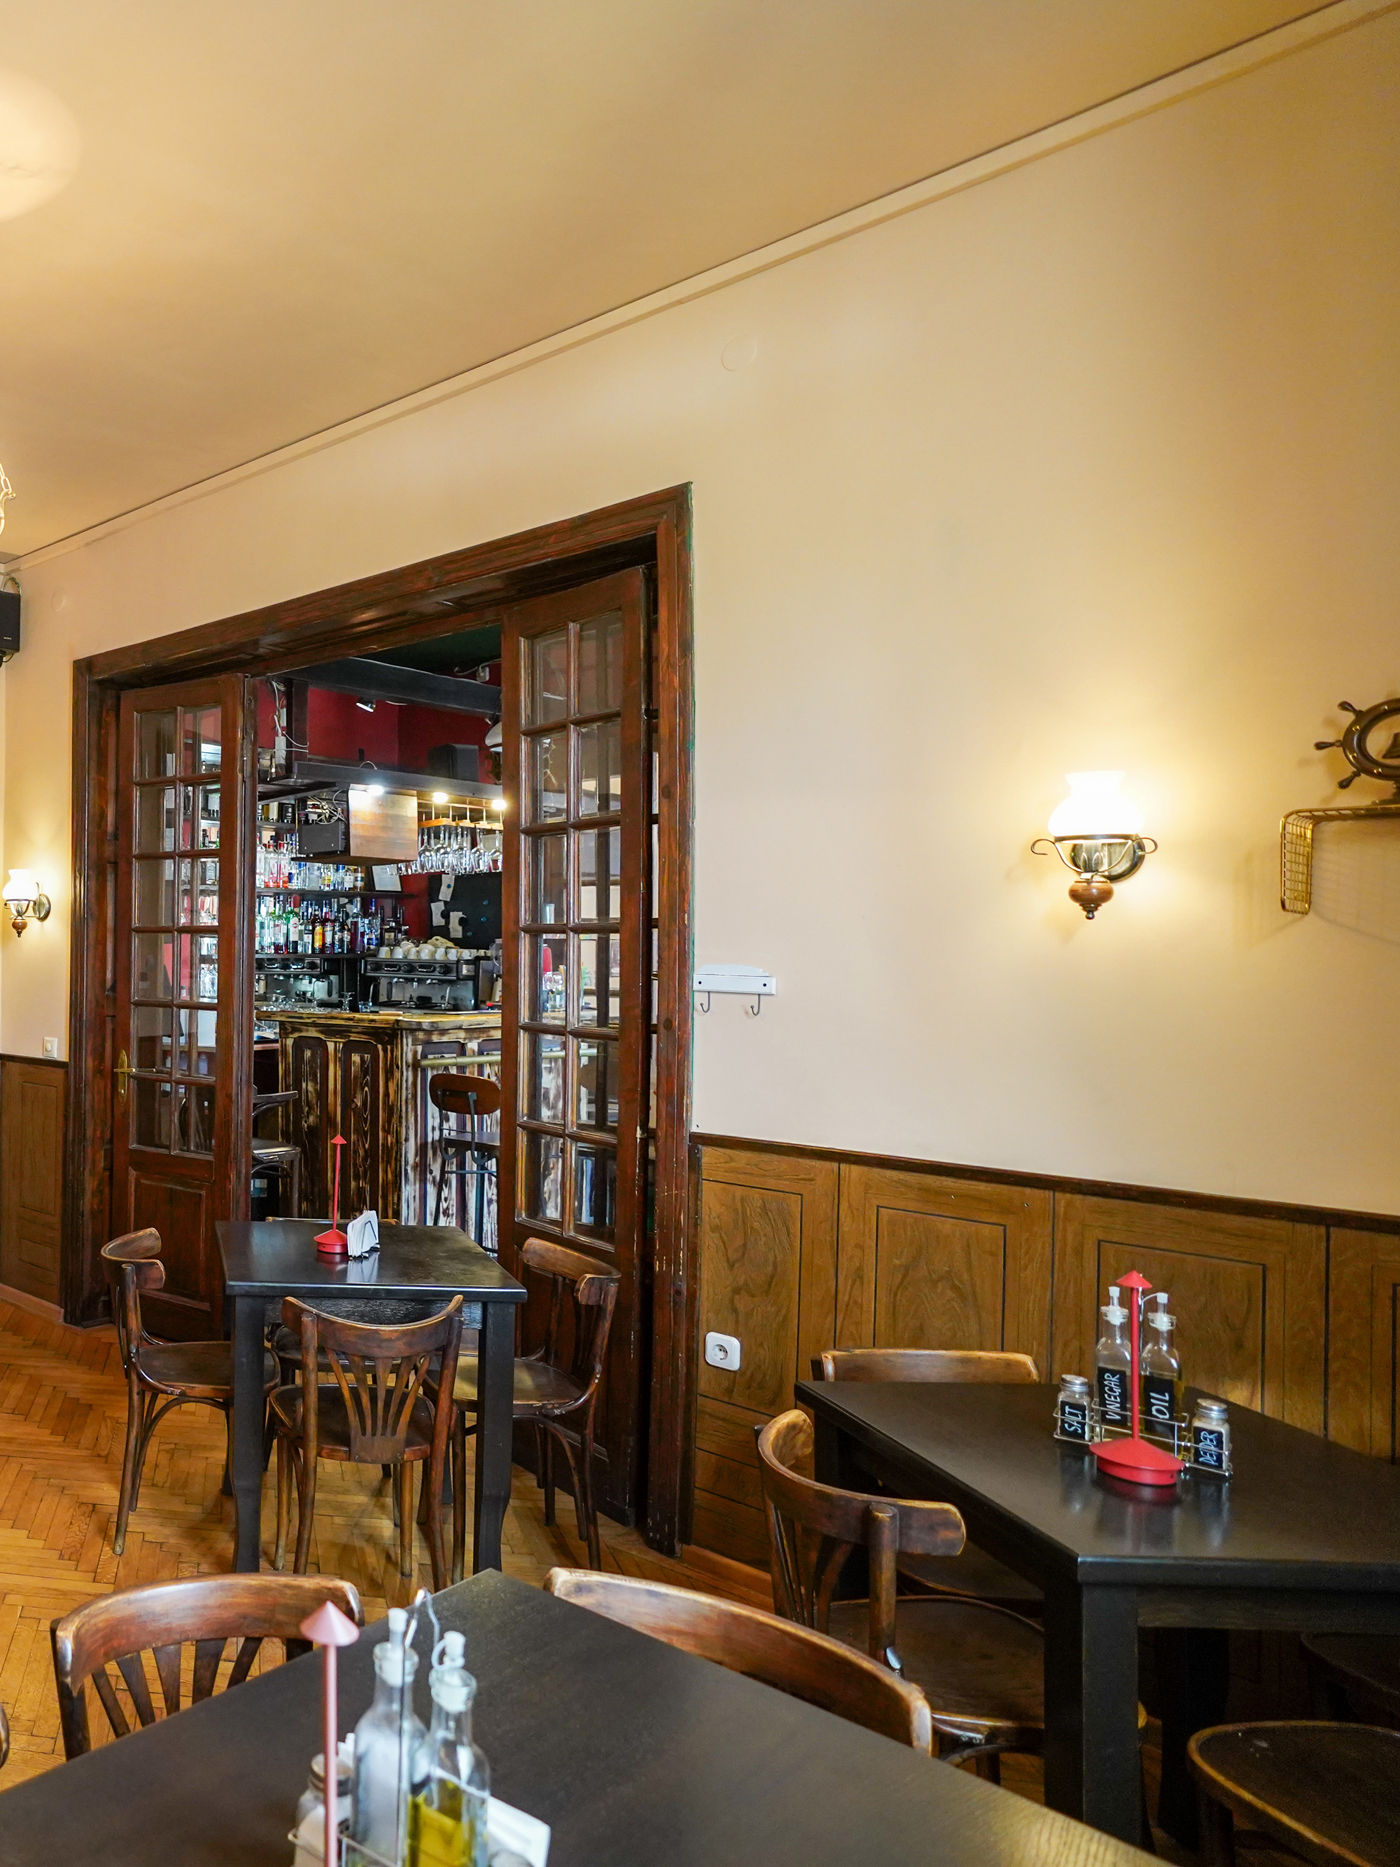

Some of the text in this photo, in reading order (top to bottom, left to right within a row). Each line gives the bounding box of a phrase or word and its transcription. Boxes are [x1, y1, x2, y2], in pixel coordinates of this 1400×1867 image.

[1103, 1372, 1122, 1420] VNEGAR
[1149, 1392, 1170, 1420] OIL
[1064, 1405, 1083, 1434] SALT
